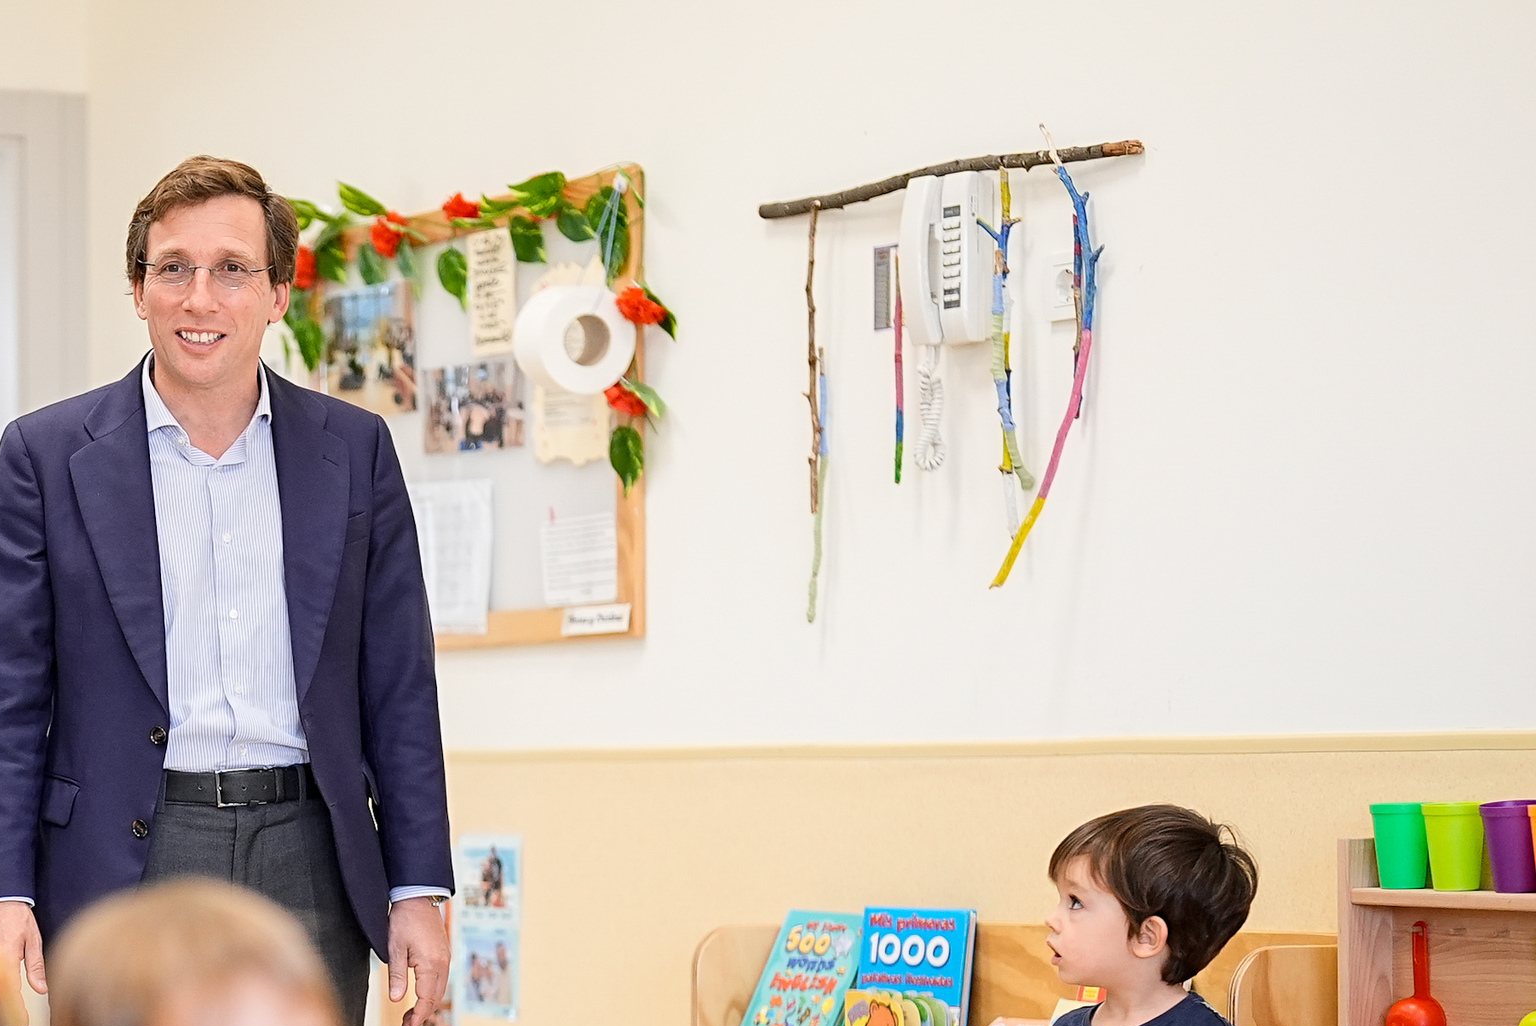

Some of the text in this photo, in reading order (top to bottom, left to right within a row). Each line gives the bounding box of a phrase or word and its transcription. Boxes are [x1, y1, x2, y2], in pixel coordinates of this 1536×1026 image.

[870, 911, 956, 933] Mis primeras
[785, 923, 832, 956] 500
[870, 931, 951, 969] 1000
[787, 956, 837, 973] WORDS
[769, 971, 838, 996] ENGLISH
